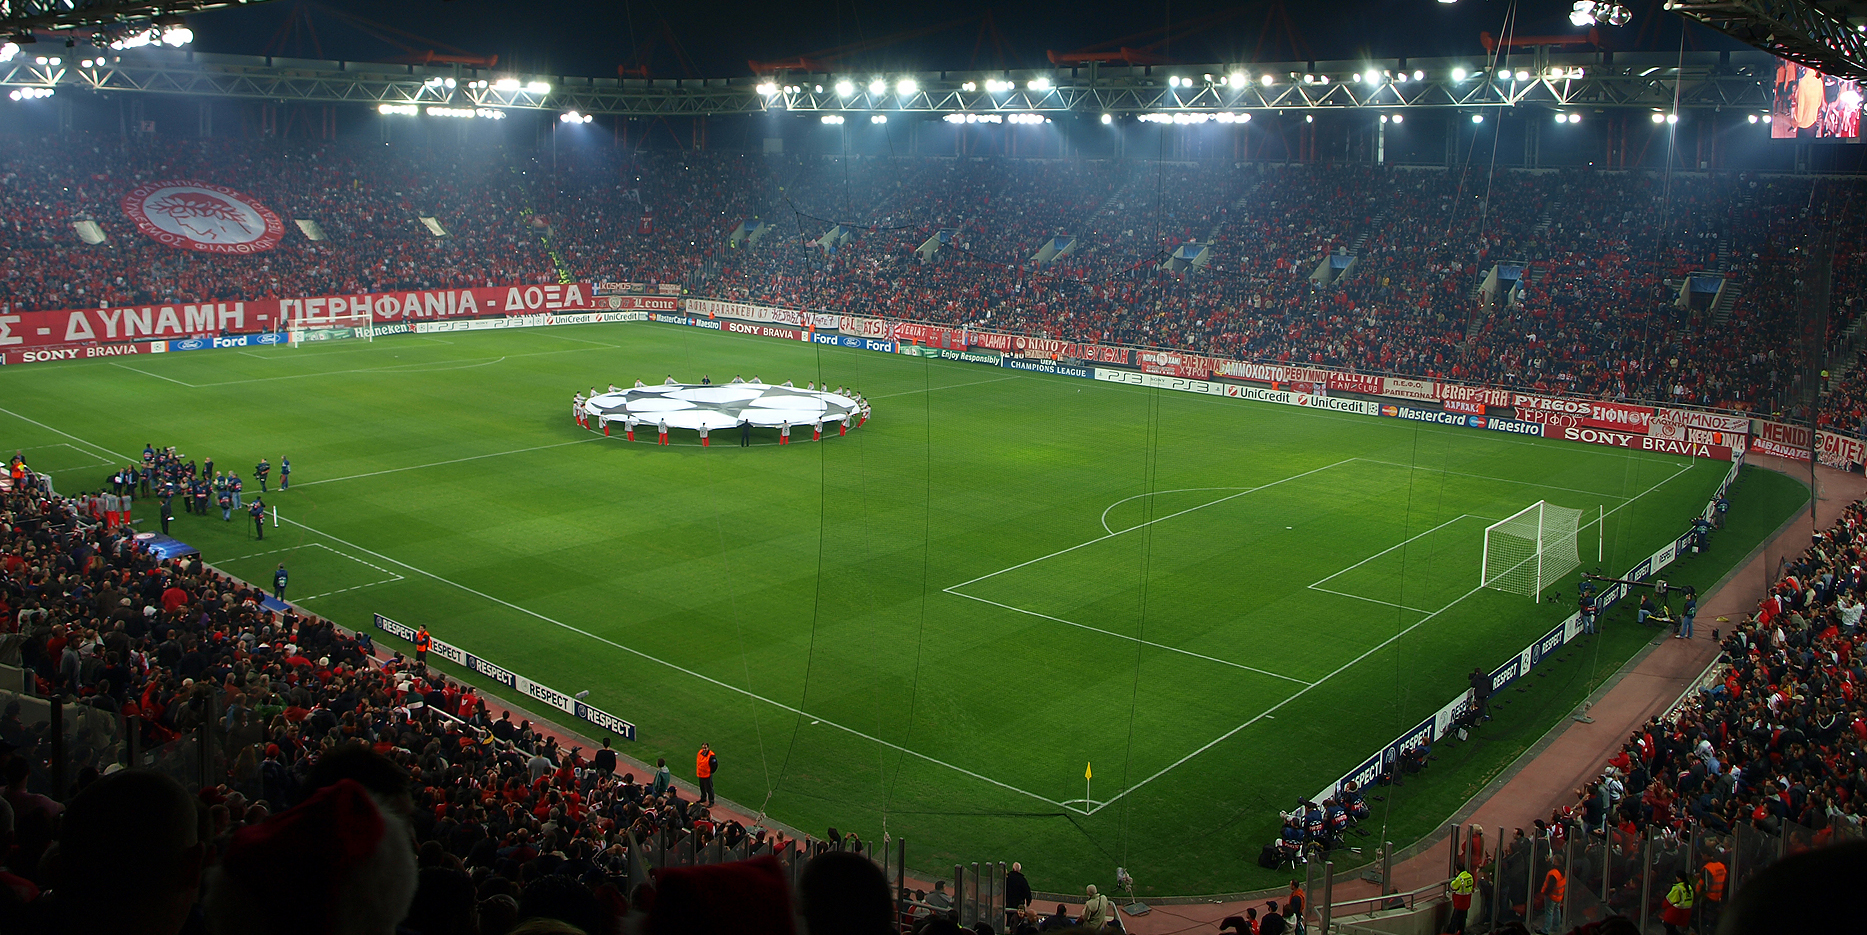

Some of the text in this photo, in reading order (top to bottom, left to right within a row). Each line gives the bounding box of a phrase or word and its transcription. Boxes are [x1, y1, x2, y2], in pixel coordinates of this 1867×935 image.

[633, 297, 674, 309] Leone
[64, 302, 245, 341] ΔΥΝΑΜΗ
[279, 290, 479, 325] ΠΕΡΗΦΑΝΙΑ
[504, 283, 584, 311] ΔΟΞΑ
[555, 315, 590, 324] UniCredit
[603, 312, 637, 321] UniCredit
[438, 321, 469, 331] PS3
[494, 318, 524, 327] PS3
[656, 313, 719, 329] MasterCard Maestro
[354, 323, 408, 338] Heineken
[729, 322, 794, 339] SONY BRAVIA
[213, 336, 247, 348] Ford
[813, 333, 838, 345] Ford
[866, 339, 892, 352] Ford
[1028, 338, 1069, 354] KIATO 7
[22, 348, 80, 363] SONY
[86, 344, 139, 357] BRAVIA
[941, 350, 960, 361] Enjoy
[960, 352, 1000, 366] Responsibly
[1135, 351, 1143, 366] 7
[1010, 360, 1087, 377] CHAMPIONS LEAGUE
[1040, 358, 1057, 366] UEFA
[1108, 370, 1143, 384] PS3
[1285, 367, 1327, 382] ΡΕΘΥΜΝΟ
[1172, 379, 1210, 393] PS3
[1330, 381, 1378, 393] FAN CLUB
[1383, 388, 1434, 400] ΡΑΠΕΤΣΩΝΑΣ
[1240, 387, 1290, 403] UniCredit
[1310, 396, 1364, 413] UniCredit
[1514, 395, 1592, 414] PYRGOS
[1398, 407, 1466, 426] MasterCard
[1488, 418, 1540, 436] Maestro
[1564, 427, 1710, 458] SONY BRAVIA
[1689, 428, 1746, 450] KEFAONIA
[382, 619, 415, 643] RESPECT
[1541, 630, 1563, 655] RESPECT
[476, 659, 513, 686] RESPECT
[1492, 662, 1518, 691] RESPECT
[529, 684, 569, 711] RESPECT
[587, 705, 631, 738] RESPECT
